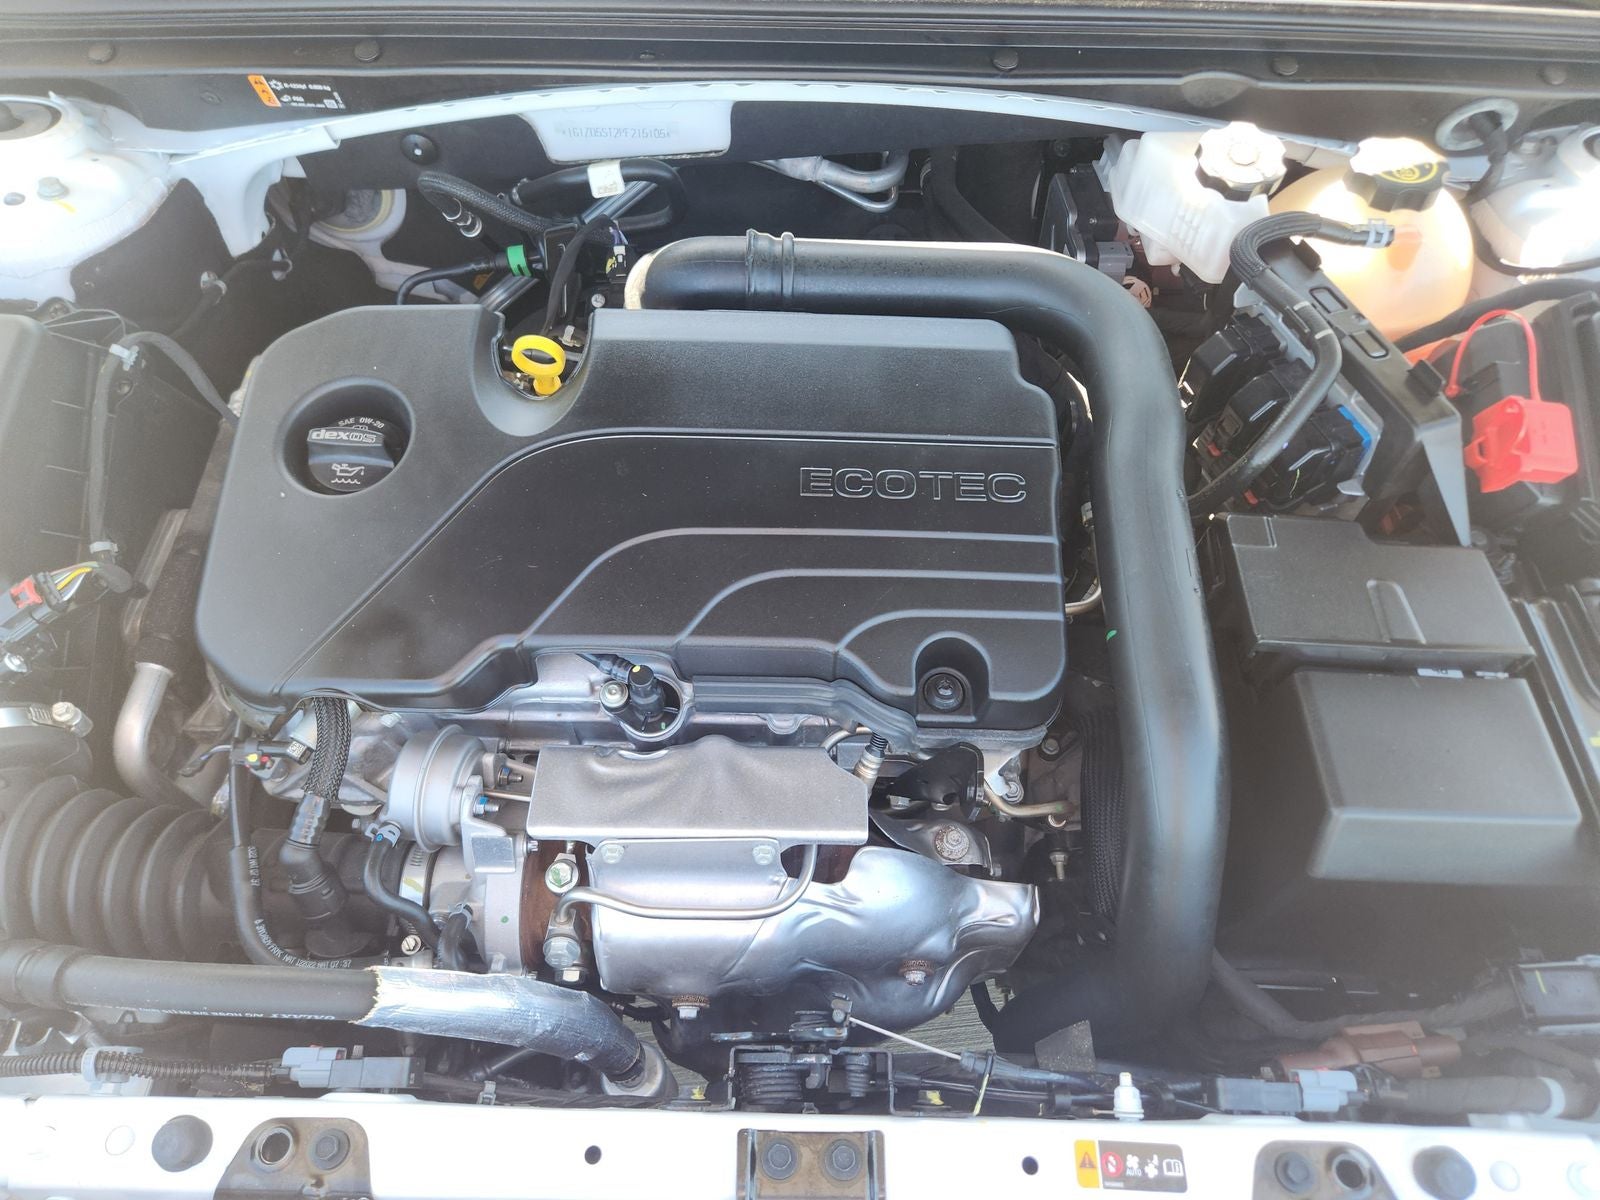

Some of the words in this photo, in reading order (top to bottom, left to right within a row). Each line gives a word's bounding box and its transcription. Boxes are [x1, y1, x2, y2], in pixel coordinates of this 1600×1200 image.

[337, 417, 355, 427] SAE
[359, 417, 385, 429] 0W-20
[311, 429, 377, 443] dexos
[800, 467, 1027, 503] ECOTEC
[1126, 1168, 1142, 1177] AUTO
